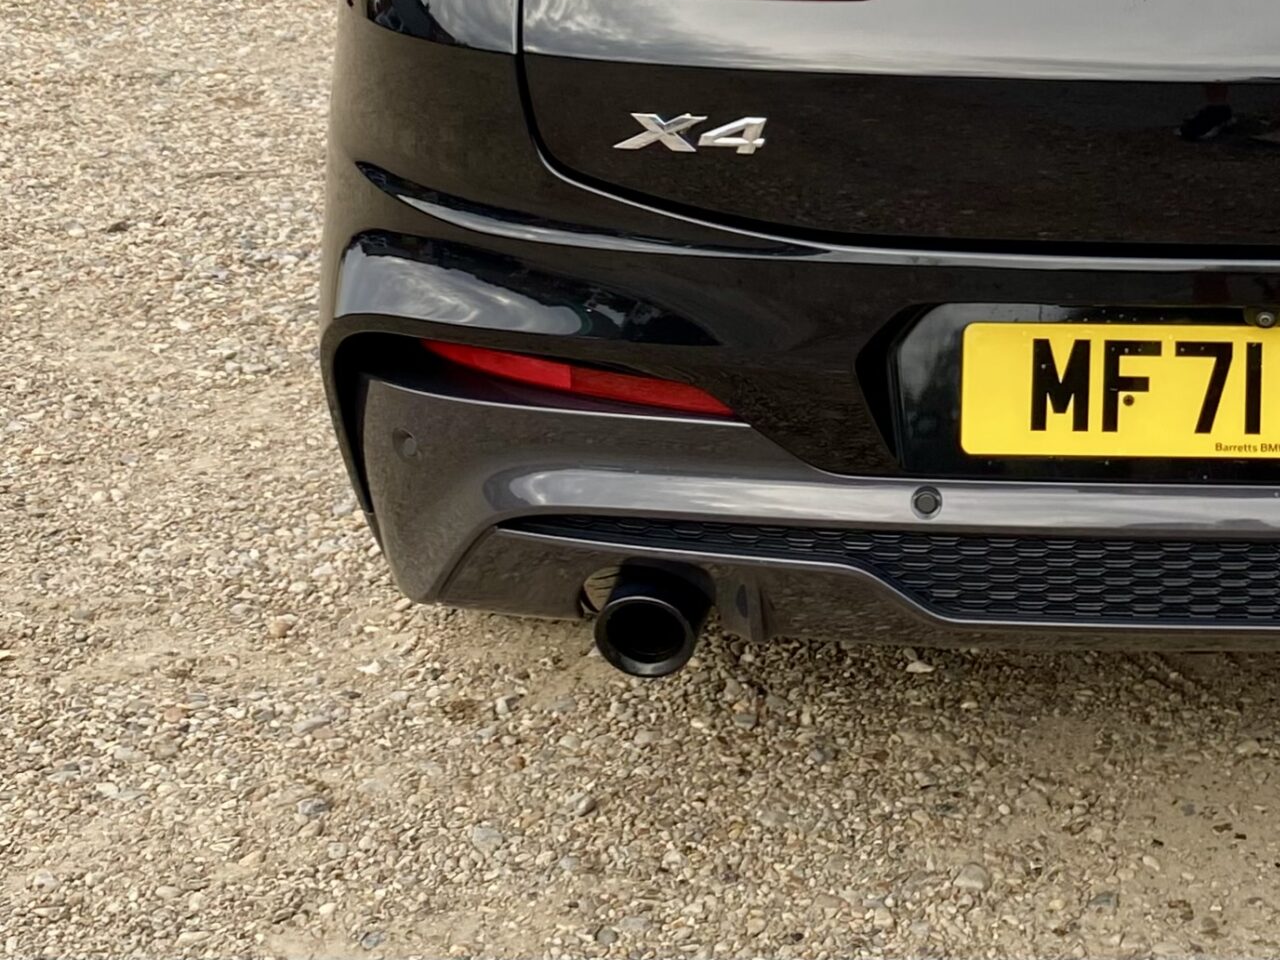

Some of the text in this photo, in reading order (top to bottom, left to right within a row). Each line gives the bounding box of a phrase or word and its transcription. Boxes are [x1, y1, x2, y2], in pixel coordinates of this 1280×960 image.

[612, 112, 768, 155] X4
[1030, 338, 1263, 436] MF71
[1215, 442, 1258, 453] Barretts
